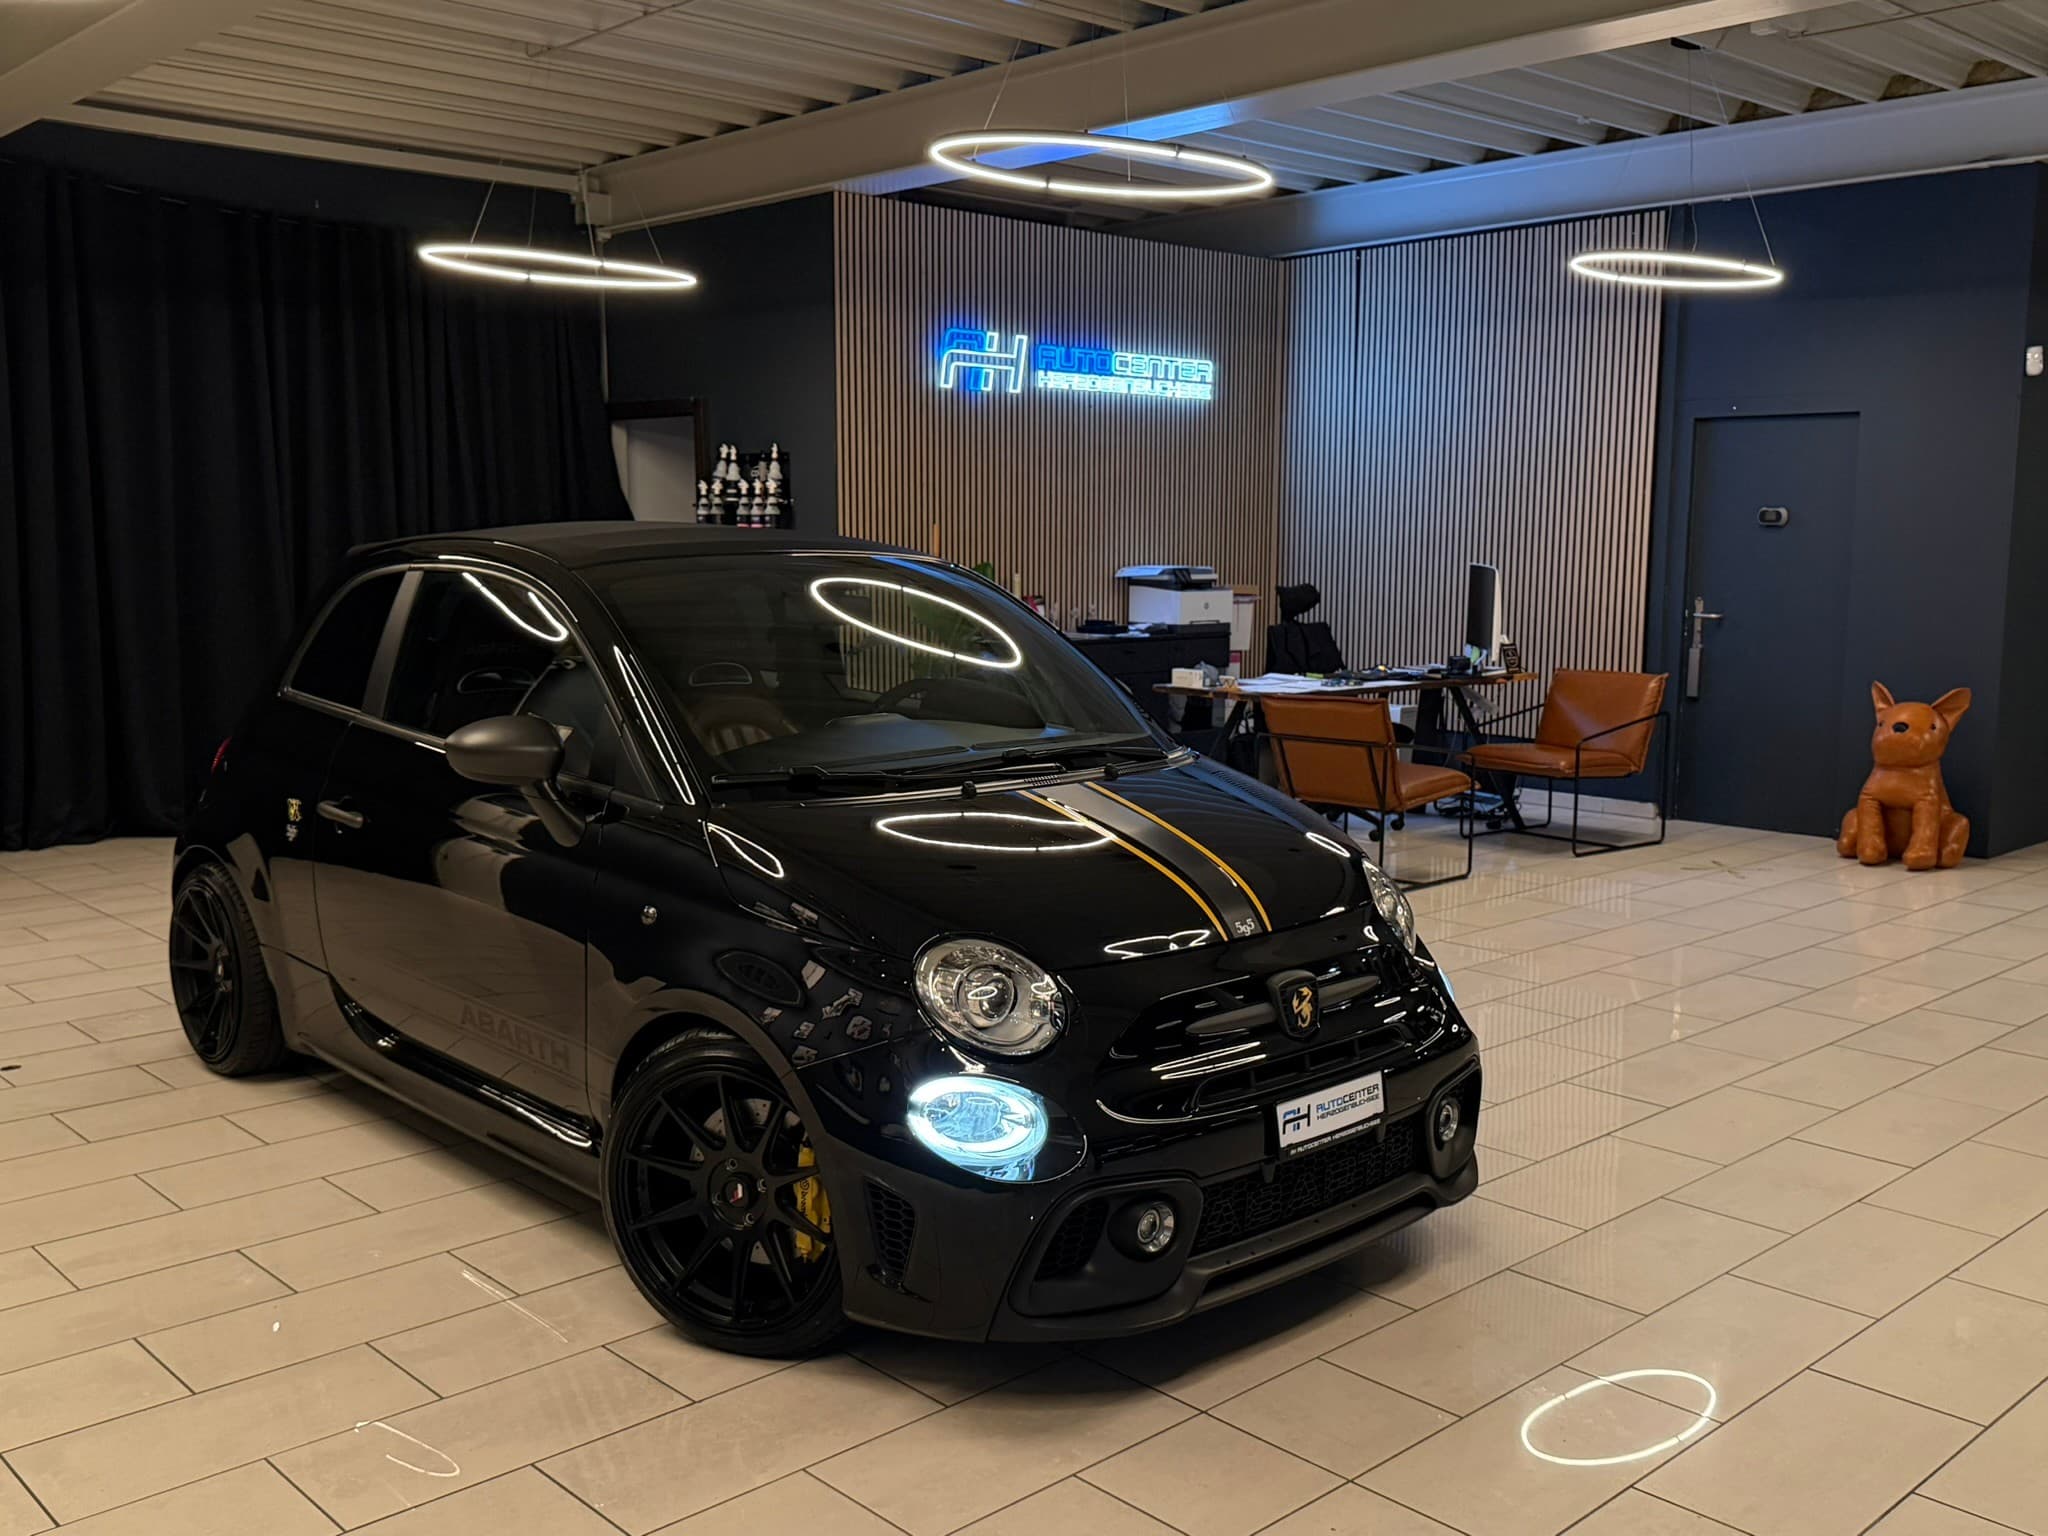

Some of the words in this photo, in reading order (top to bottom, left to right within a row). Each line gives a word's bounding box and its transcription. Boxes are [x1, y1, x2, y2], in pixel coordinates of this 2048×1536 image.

[1234, 918, 1255, 936] 595
[461, 1002, 570, 1072] ABARTH
[1316, 1083, 1380, 1114] AUTOCENTER
